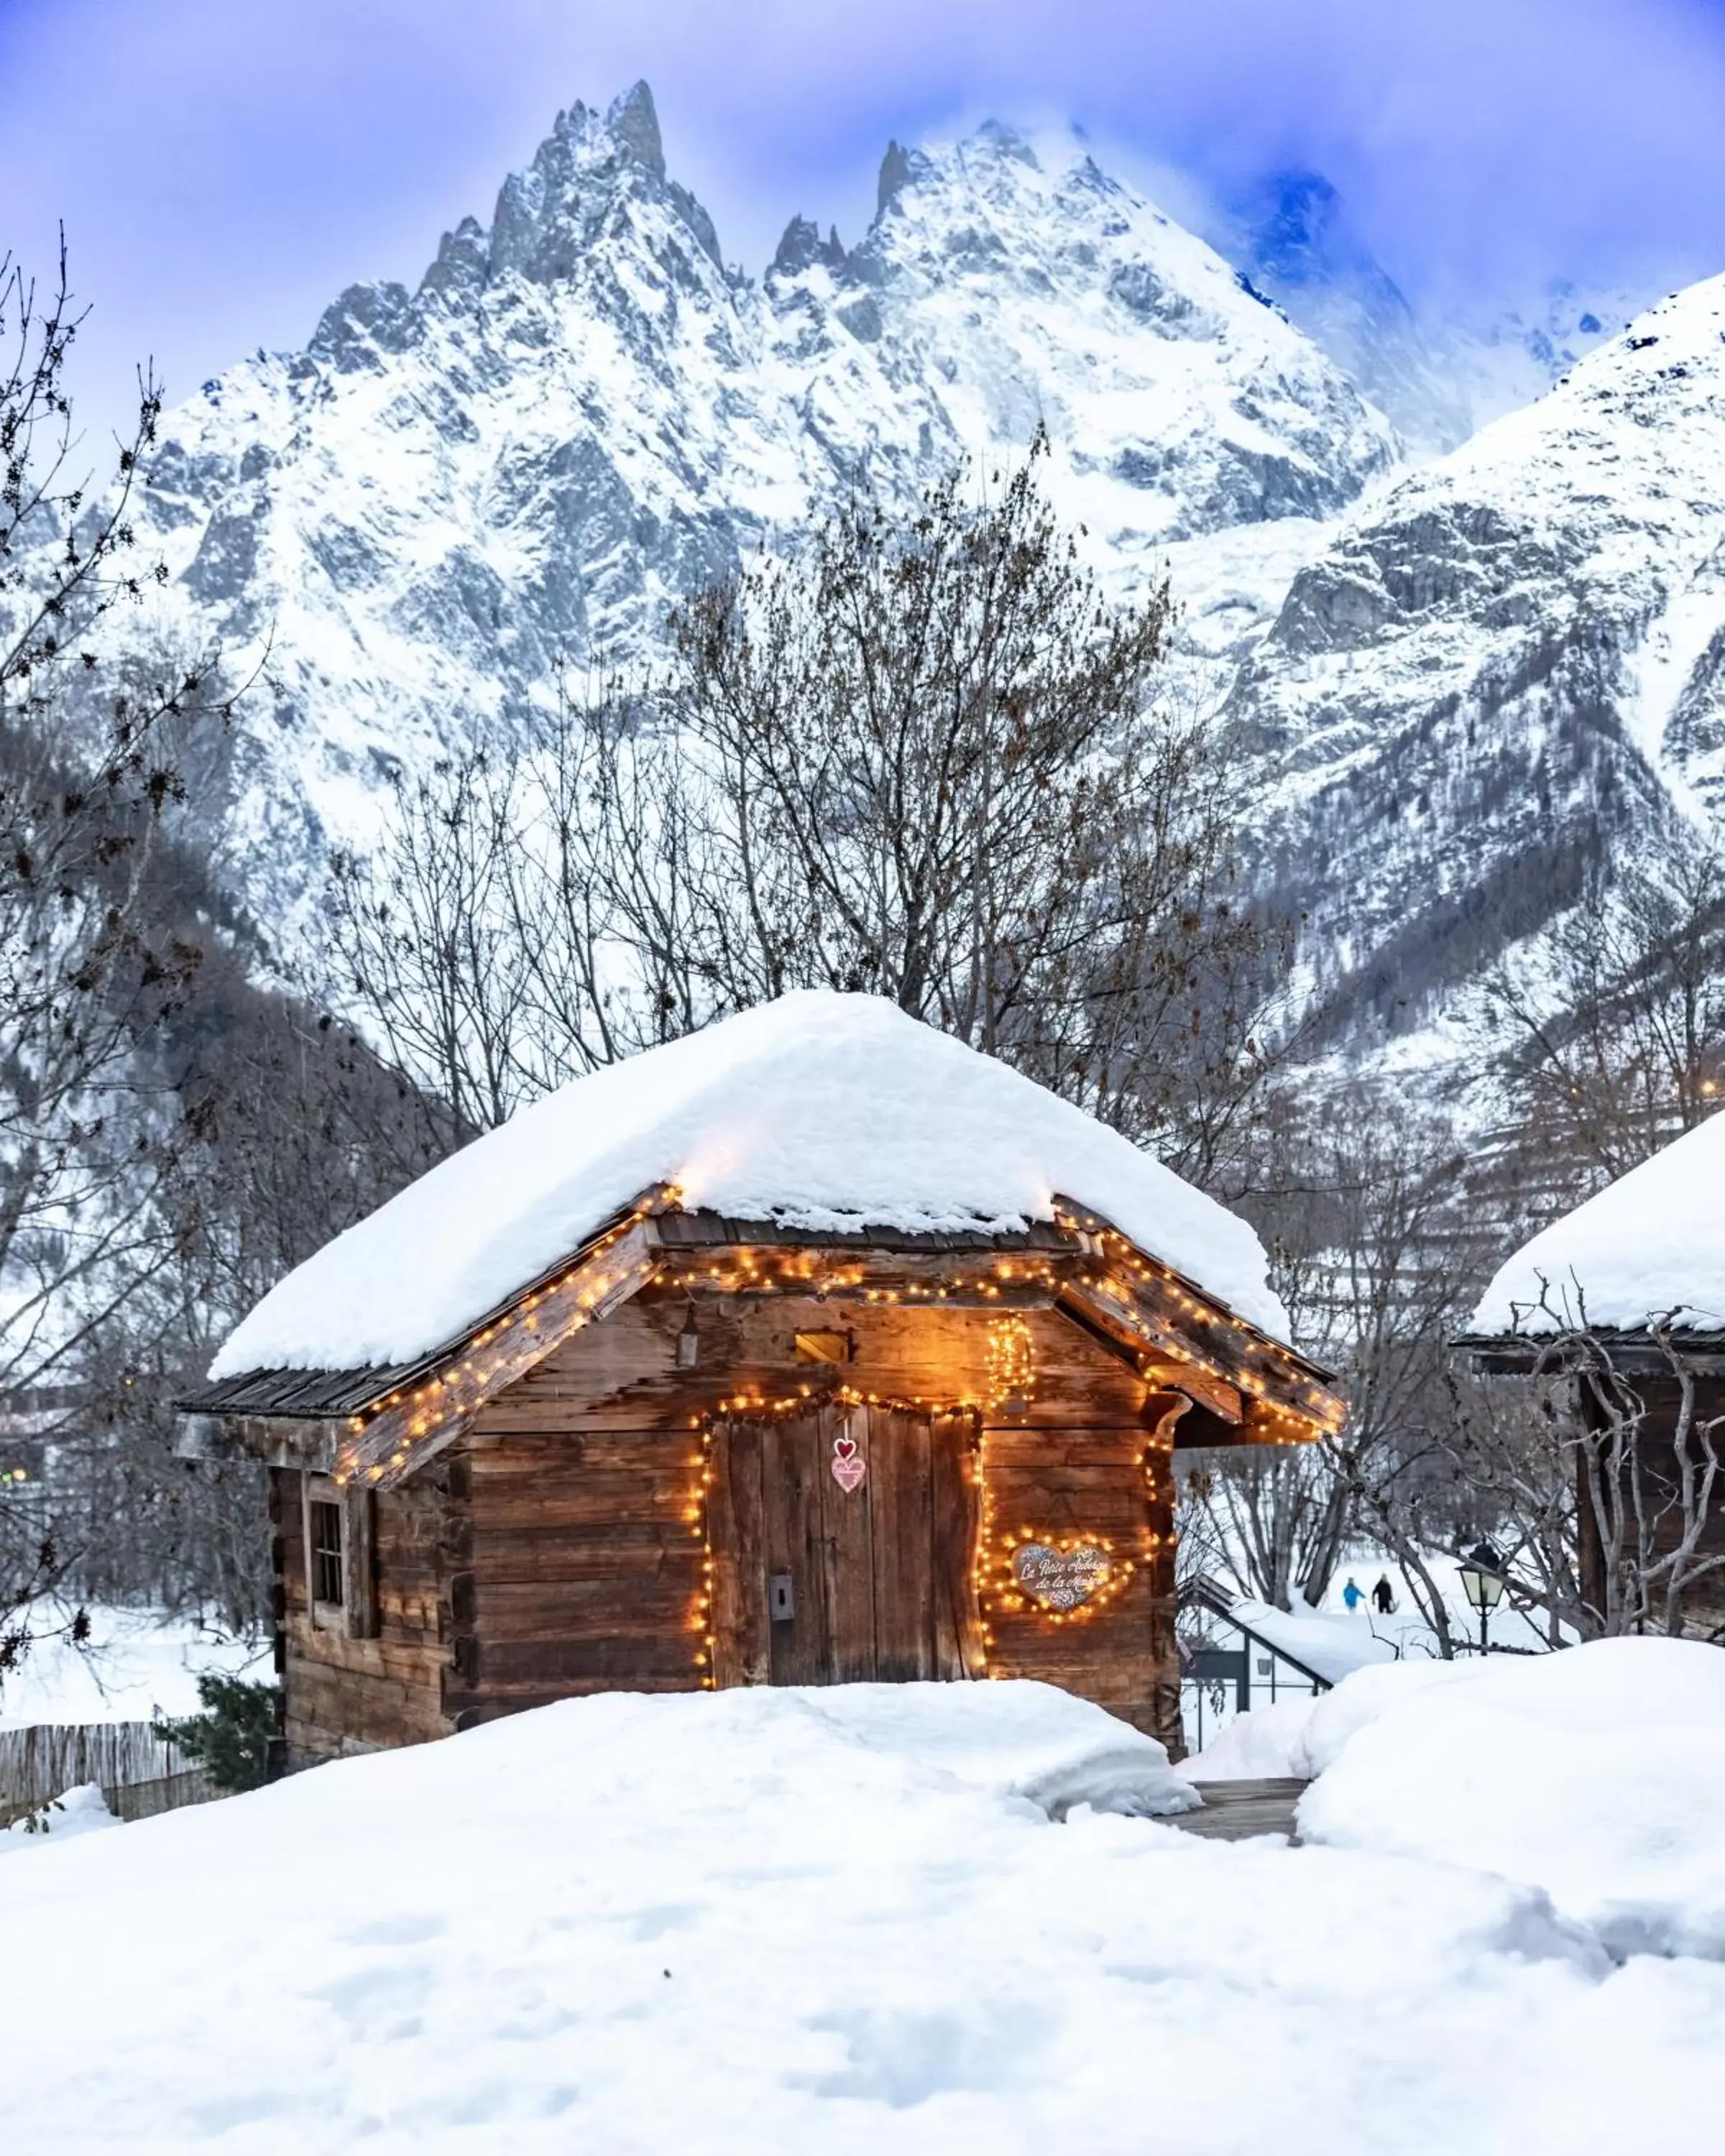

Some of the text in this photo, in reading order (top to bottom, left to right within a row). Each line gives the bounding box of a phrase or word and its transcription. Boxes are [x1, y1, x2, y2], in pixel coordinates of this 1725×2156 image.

[1020, 1563, 1035, 1580] La
[1039, 1559, 1065, 1577] Petite
[1035, 1576, 1050, 1589] de
[1052, 1575, 1064, 1588] la
